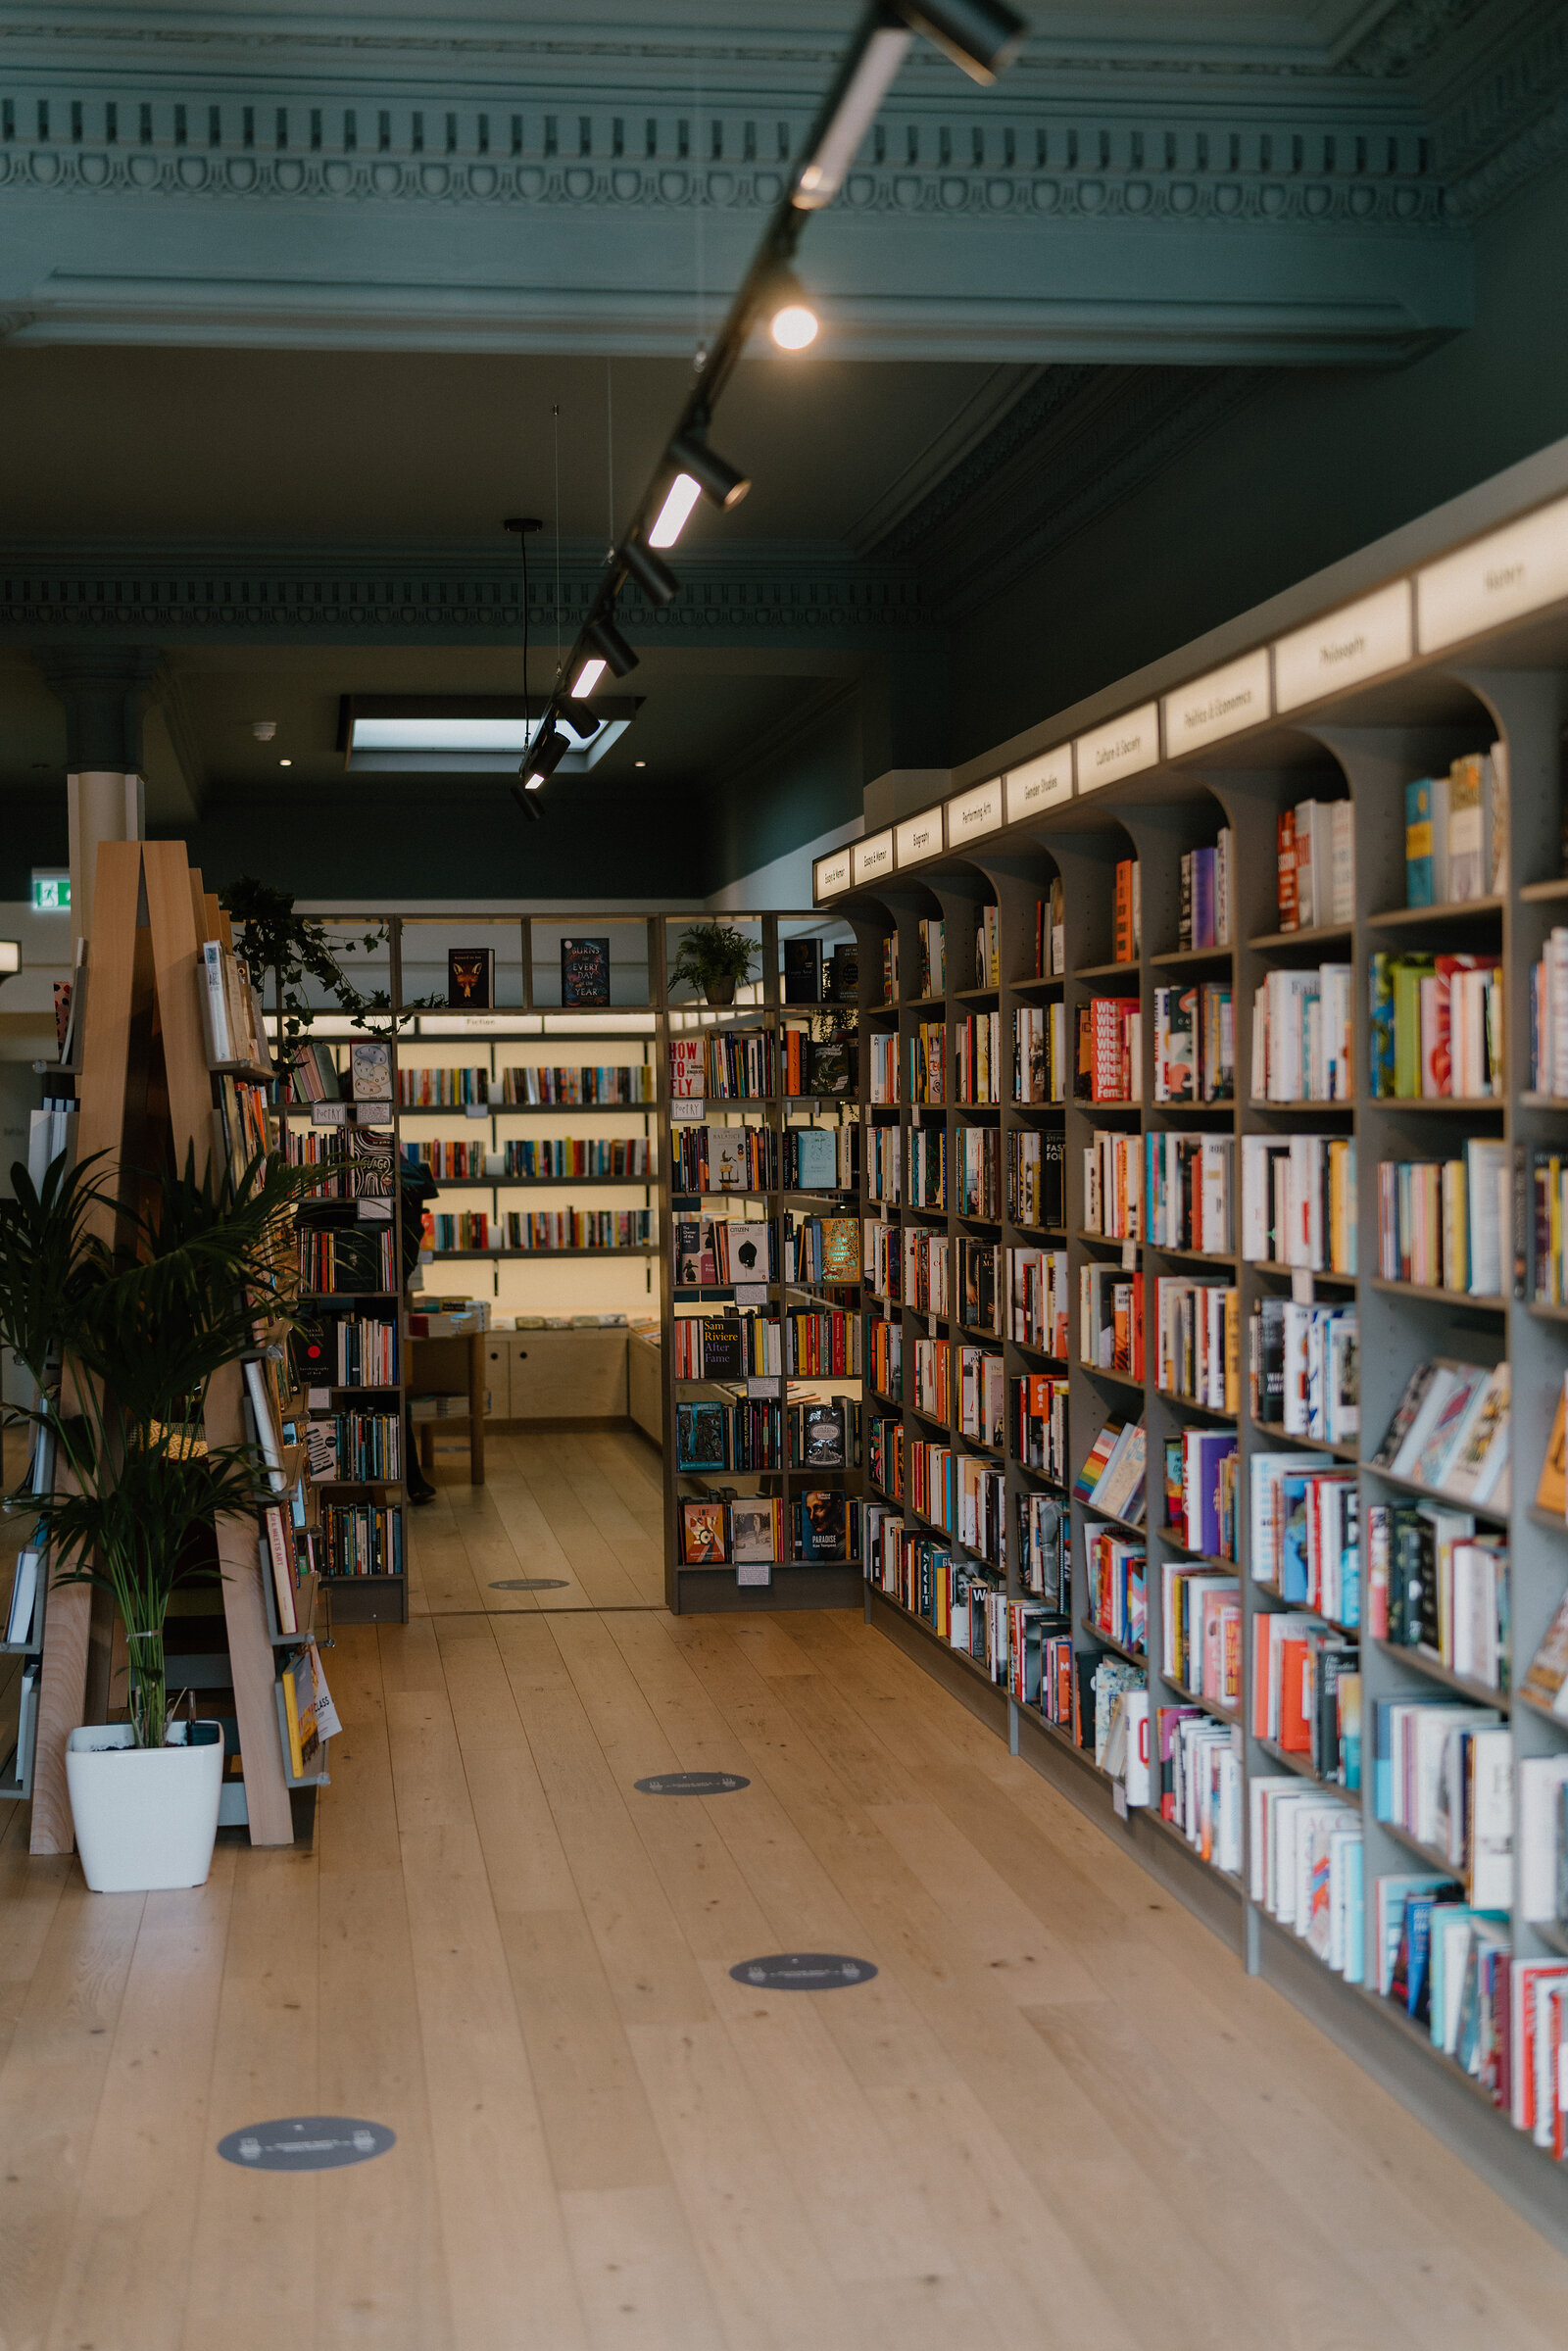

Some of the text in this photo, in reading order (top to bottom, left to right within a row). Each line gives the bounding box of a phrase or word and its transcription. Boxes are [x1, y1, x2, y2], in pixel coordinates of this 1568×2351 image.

[1319, 636, 1365, 664] Philosophy
[1185, 709, 1207, 728] Politics
[1215, 691, 1251, 716] Economics
[1096, 748, 1114, 766] Culture
[1121, 737, 1141, 756] Society
[1025, 777, 1057, 800] Gender Studies
[962, 808, 983, 823] Performing
[913, 831, 930, 848] Biography
[669, 1042, 697, 1059] HOW
[669, 1061, 685, 1078] TO
[670, 1078, 693, 1097] FLY
[364, 1159, 388, 1170] SURGE
[705, 1321, 724, 1331] Sam
[705, 1331, 739, 1342] Riviere
[705, 1343, 729, 1352] After
[705, 1353, 729, 1363] Fame
[272, 1528, 282, 1552] MEETS
[811, 1535, 836, 1543] PARADISE
[275, 1553, 284, 1567] ART
